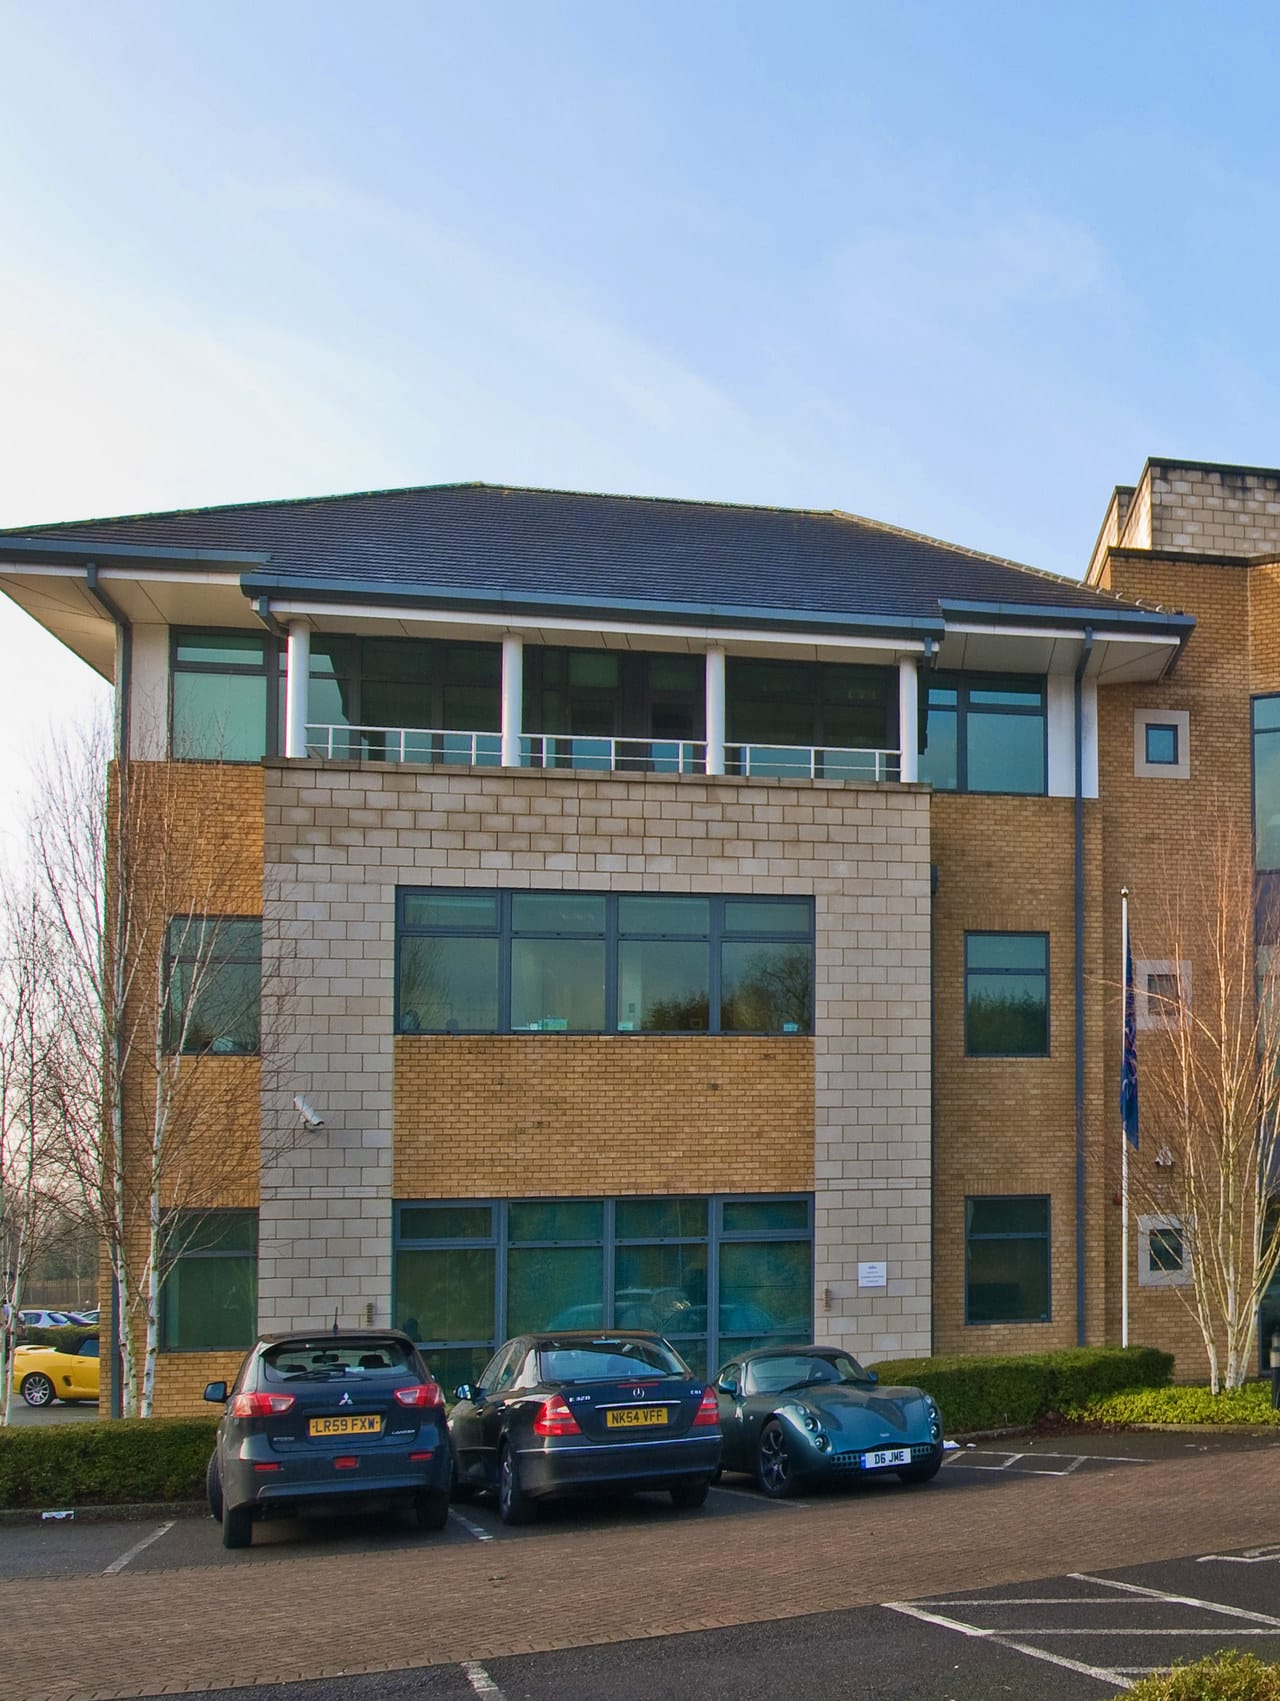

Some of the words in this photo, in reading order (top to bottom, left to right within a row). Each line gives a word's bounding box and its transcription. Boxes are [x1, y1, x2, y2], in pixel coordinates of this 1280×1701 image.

[611, 1410, 640, 1425] NK54
[642, 1408, 663, 1422] VFF
[315, 1418, 348, 1433] LR59
[351, 1417, 375, 1431] FXW
[874, 1453, 886, 1465] D6
[889, 1450, 905, 1463] JME
